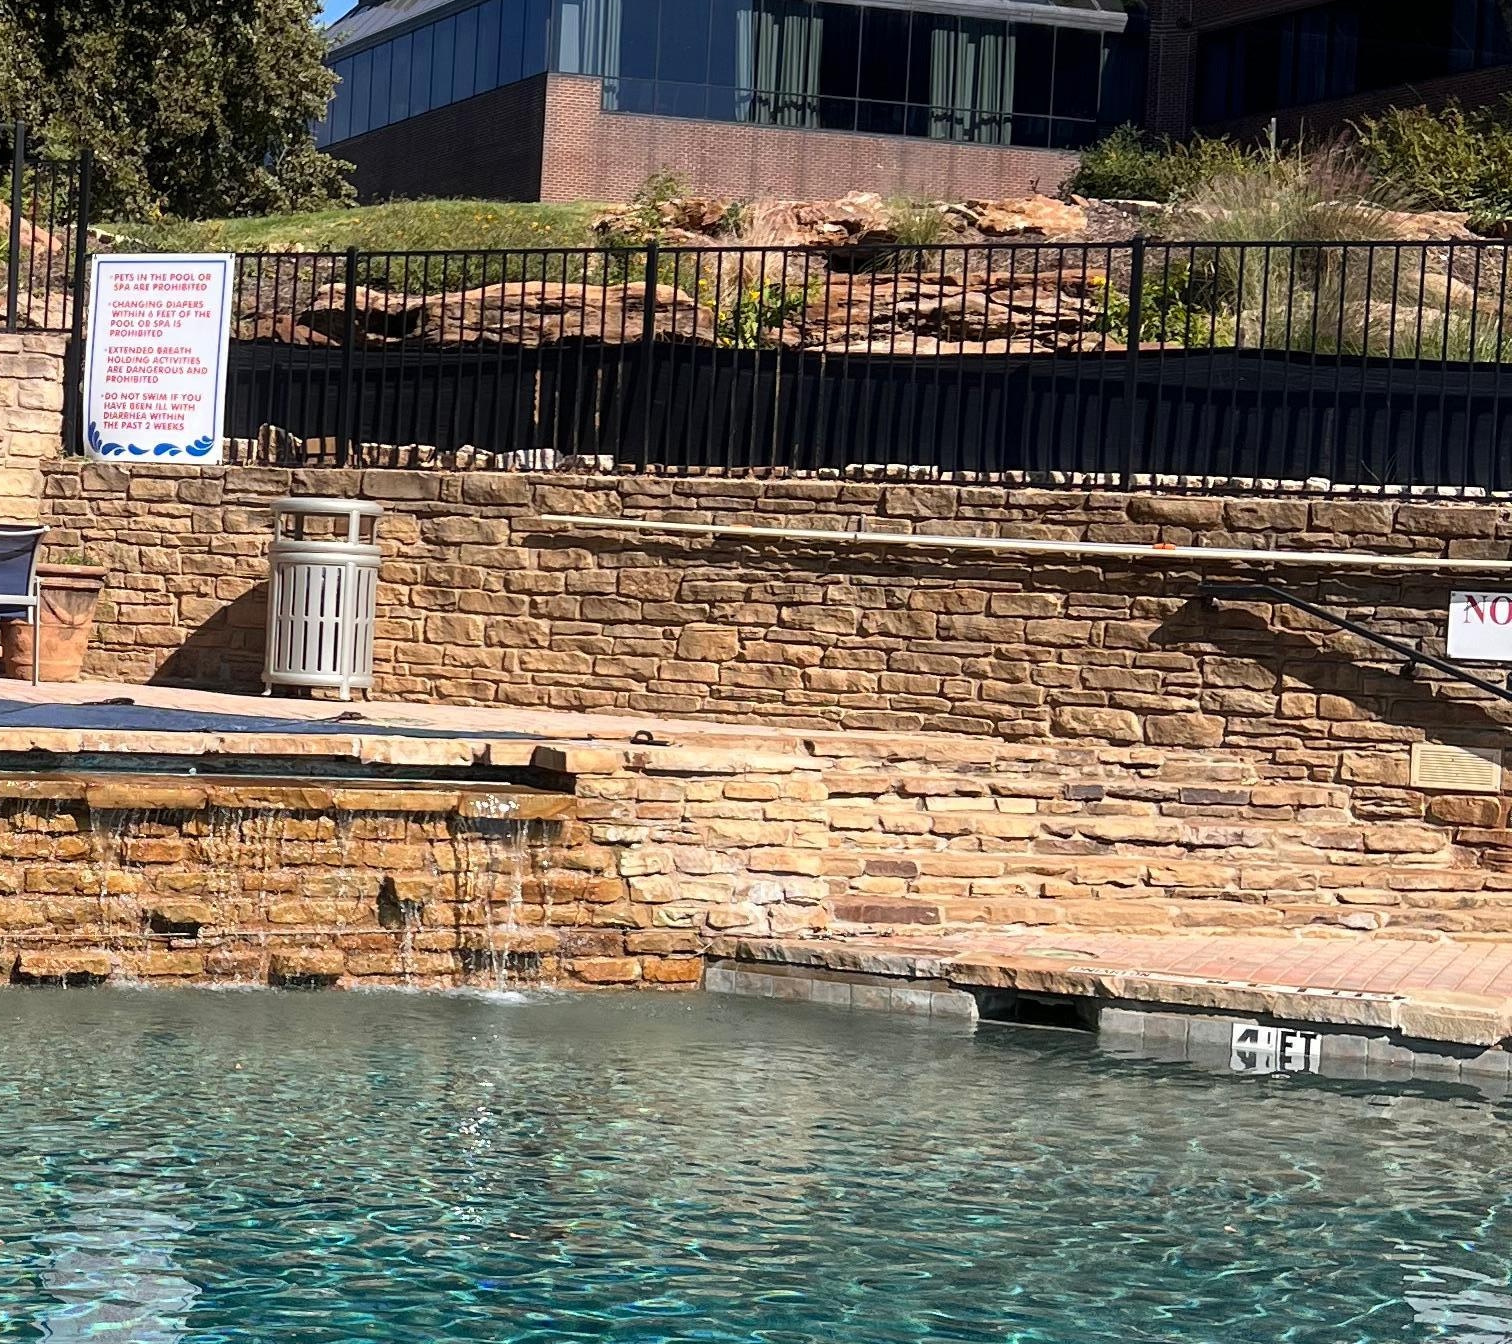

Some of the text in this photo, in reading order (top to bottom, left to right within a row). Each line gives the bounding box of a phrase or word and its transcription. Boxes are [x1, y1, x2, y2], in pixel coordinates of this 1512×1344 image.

[114, 273, 212, 282] PETS IN THE POOL OR
[113, 283, 130, 292] SPA
[152, 283, 208, 291] PROHIBITED
[166, 301, 204, 309] DIAPERS
[112, 310, 145, 318] WITHIN
[156, 310, 176, 318] FEET
[178, 310, 191, 318] OF
[194, 310, 211, 318] THE
[110, 320, 182, 328] POOL OR SPA IS
[109, 329, 163, 338] PROHIBITED
[108, 346, 154, 354] EXTENDED
[107, 356, 201, 365] HOLDING ACTIVITIES
[107, 365, 208, 375] ARE DANGEROUS AND
[105, 376, 159, 384] PROHIBITED
[120, 393, 140, 401] NOT
[142, 393, 167, 401] SWIM
[170, 393, 179, 401] IF
[181, 394, 202, 402] YOU
[104, 402, 127, 410] HAVE
[129, 402, 152, 410] BEEN
[171, 403, 196, 411] WITH
[103, 412, 185, 421] DIARRHEA WITHIN
[103, 421, 119, 429] THE
[145, 422, 151, 430] 2
[153, 422, 185, 430] WEEKS
[1280, 1030, 1317, 1056] FT
